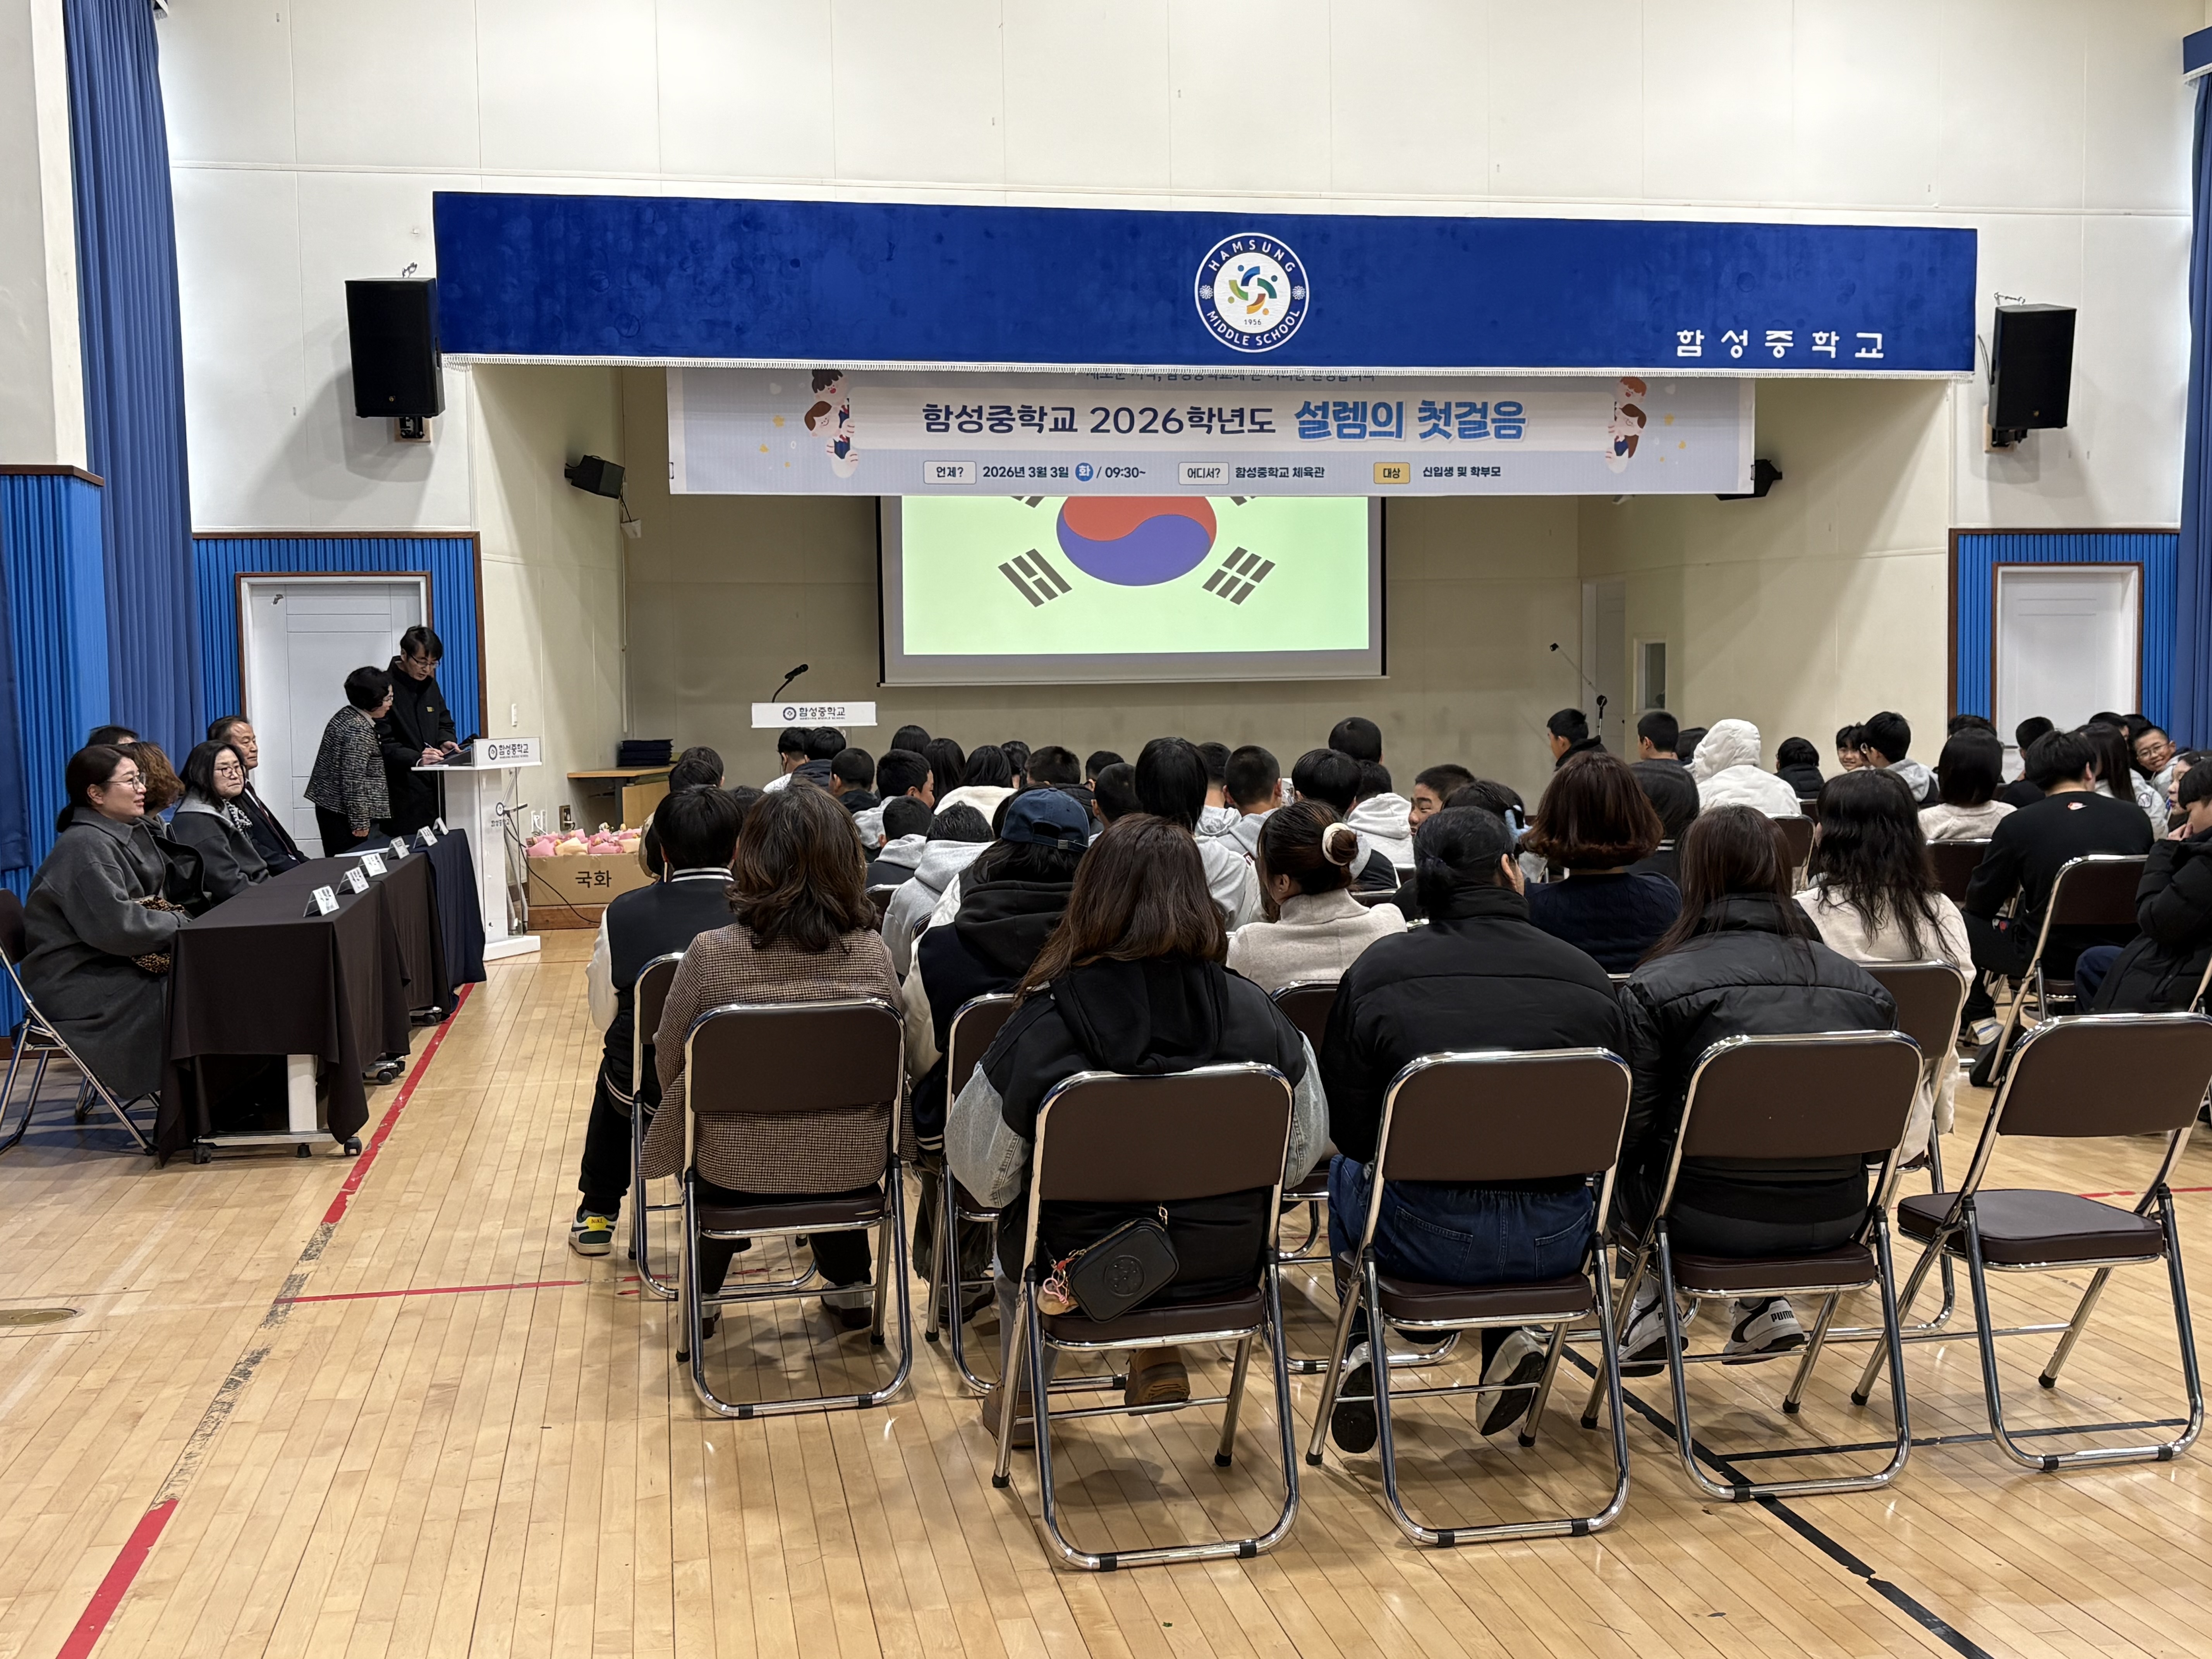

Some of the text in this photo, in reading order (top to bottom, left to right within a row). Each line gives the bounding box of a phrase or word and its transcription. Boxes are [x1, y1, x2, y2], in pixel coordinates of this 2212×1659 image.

[1208, 240, 1295, 272] HAMSUNG
[1207, 310, 1300, 346] MIDDLE SCHOOL
[1676, 329, 1884, 359] 함성중학교
[922, 399, 1527, 440] 함성중학교 2026학년도 설렘의 첫걸음
[936, 465, 1146, 479] 언제? 2026년 3월 3일 화 / 09:30~
[1187, 466, 1325, 479] 어디서? 함성중학교 체육관
[1383, 466, 1501, 479] 대상 신입생 및 학부모
[799, 707, 845, 717] 함성중학교
[499, 744, 529, 755] 함성중학교
[575, 870, 612, 888] 국화
[1658, 1312, 1682, 1321] PA
